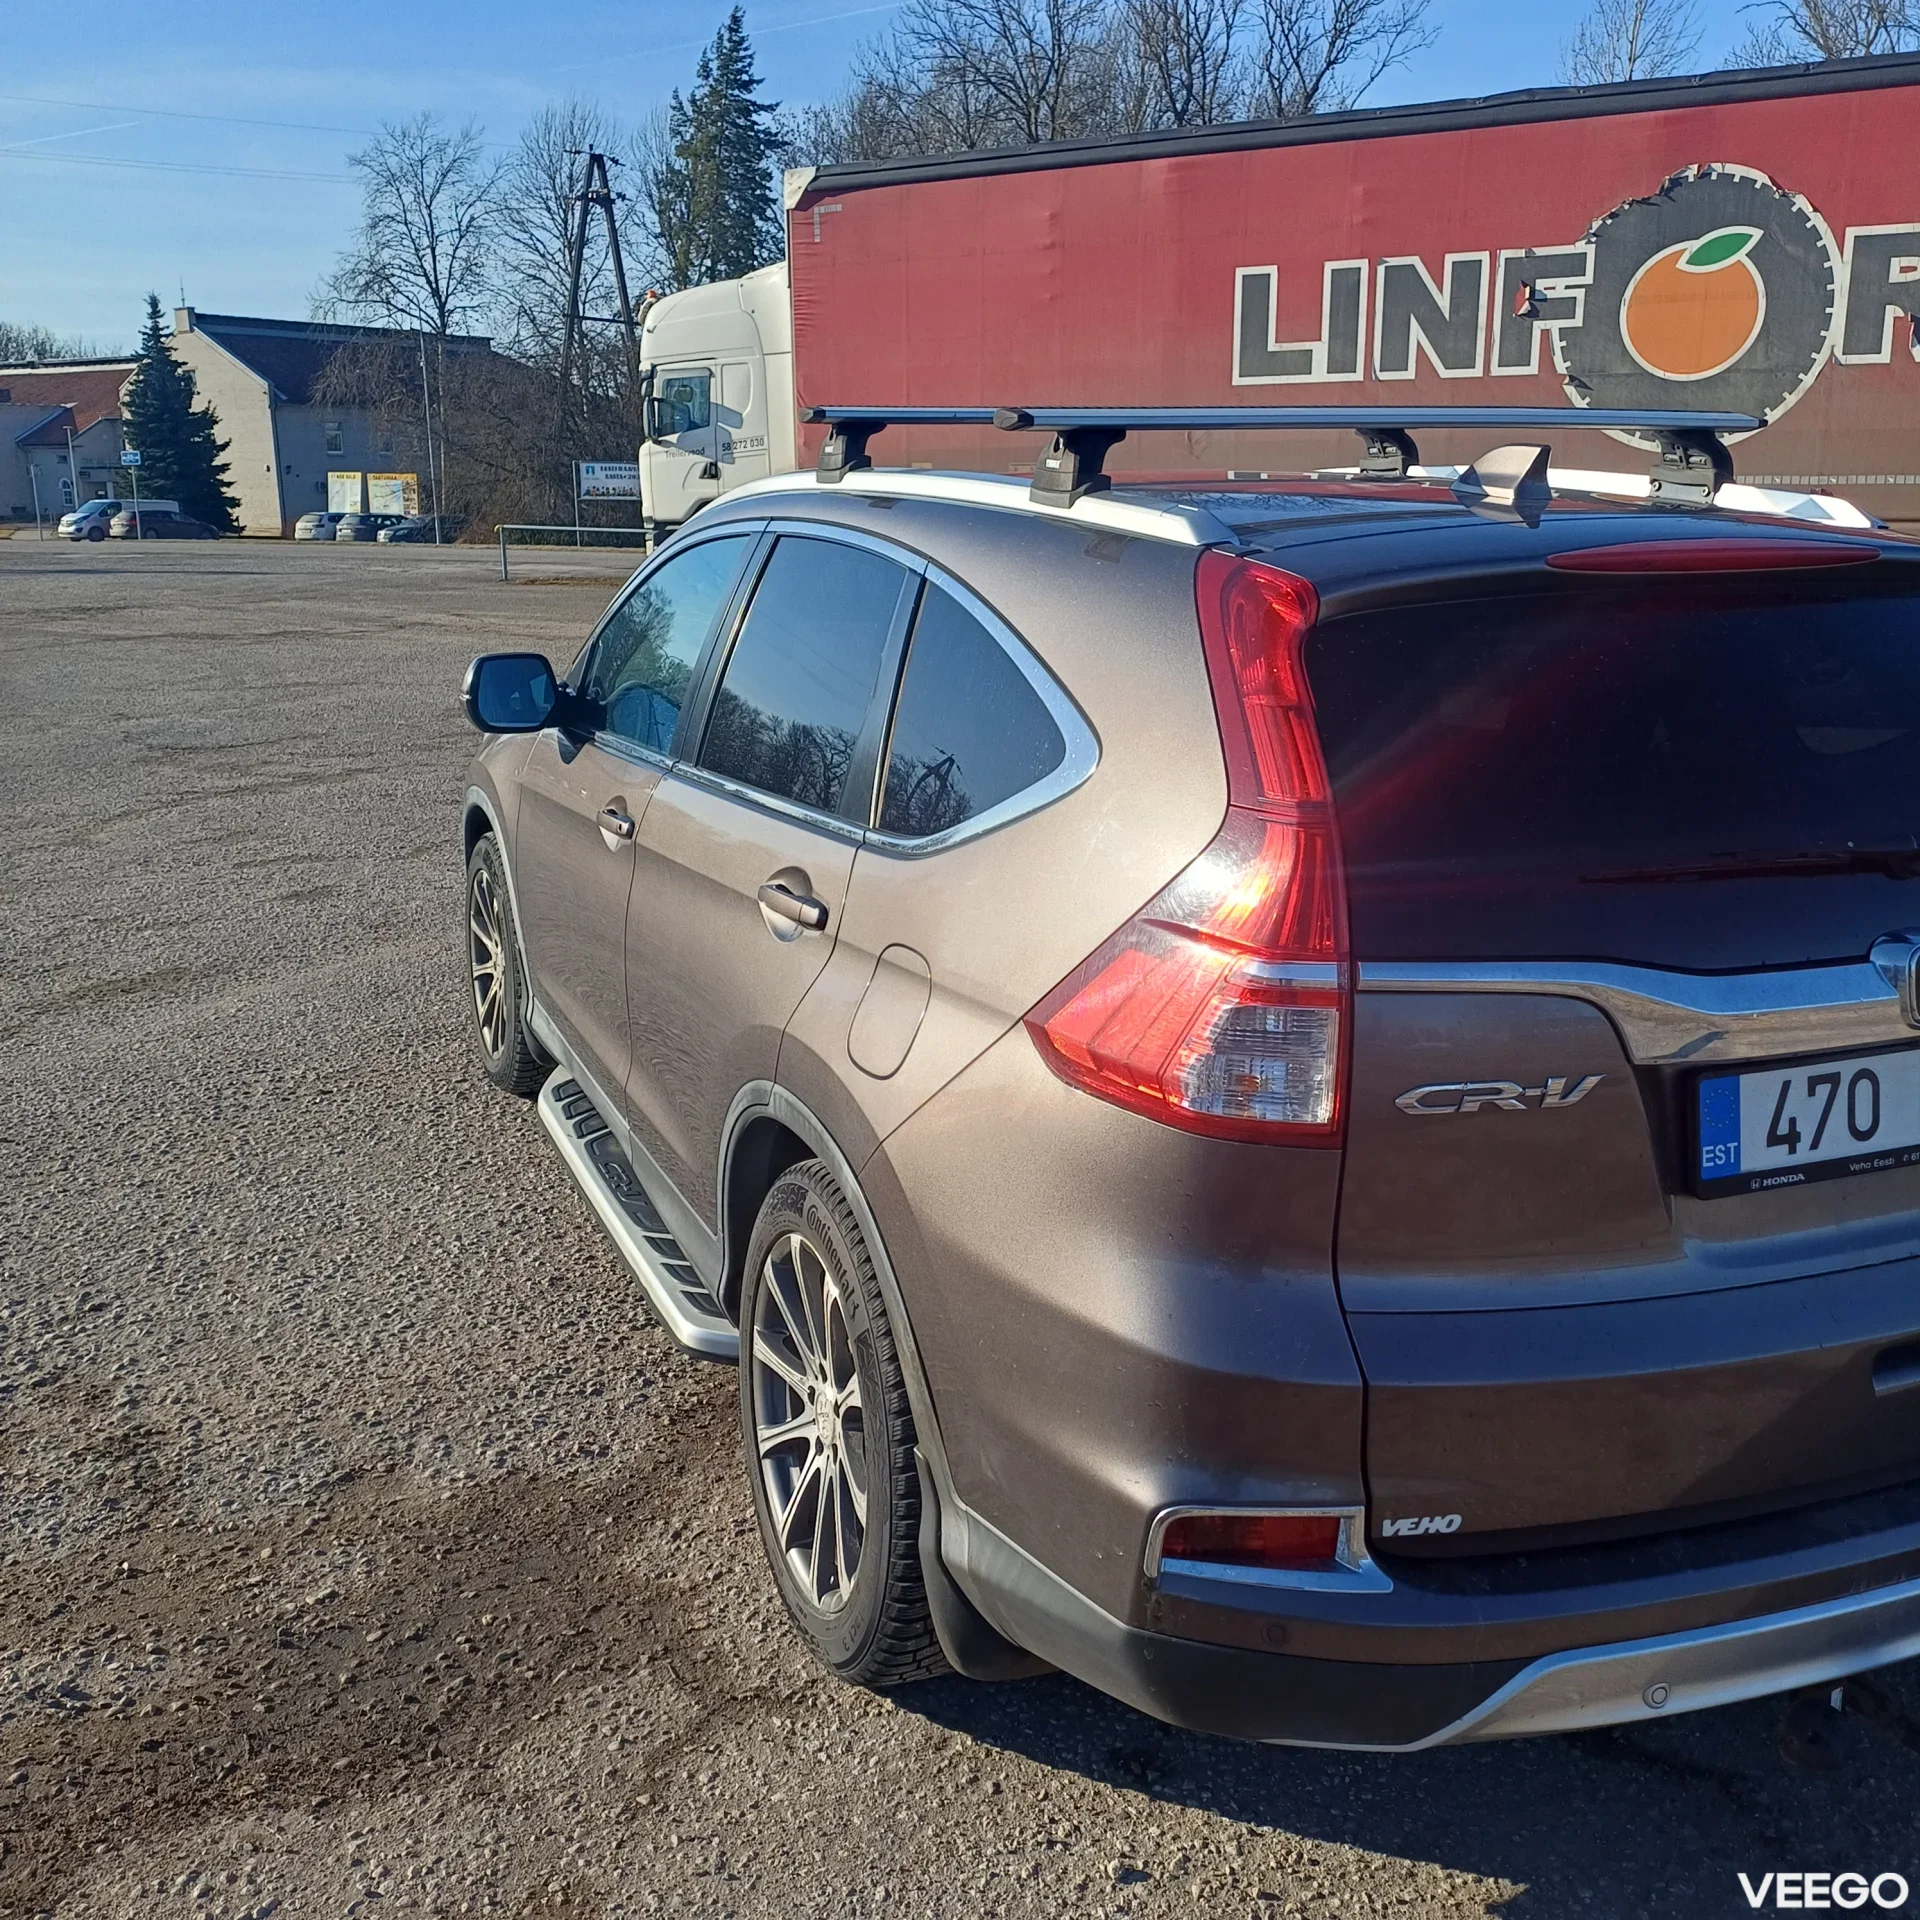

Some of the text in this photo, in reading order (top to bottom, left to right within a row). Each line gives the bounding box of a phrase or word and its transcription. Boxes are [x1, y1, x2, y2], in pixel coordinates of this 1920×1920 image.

[722, 438, 764, 451] 58 272 030
[1395, 1073, 1607, 1115] CR-V
[1767, 1068, 1880, 1155] 470
[1702, 1142, 1738, 1167] EST
[1849, 1160, 1871, 1172] Veho
[1873, 1157, 1896, 1168] Eesti
[1762, 1173, 1806, 1187] HONDA
[805, 1203, 856, 1304] Continental
[1382, 1514, 1462, 1537] VEHO
